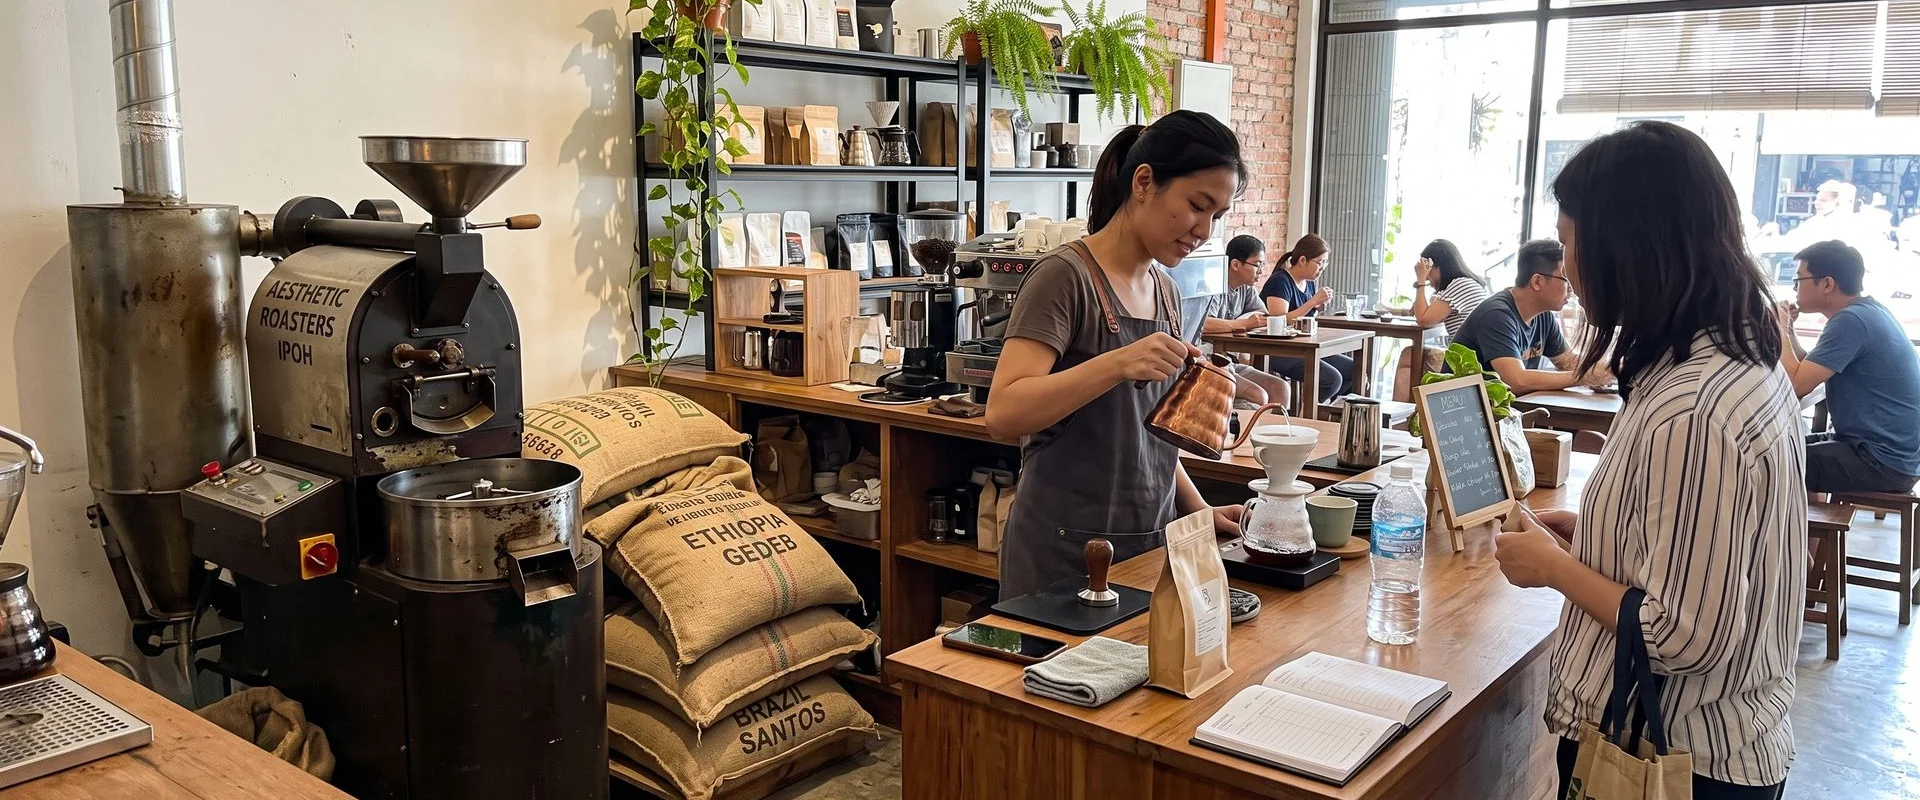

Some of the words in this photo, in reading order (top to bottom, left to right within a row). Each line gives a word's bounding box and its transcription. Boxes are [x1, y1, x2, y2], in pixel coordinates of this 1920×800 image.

[266, 280, 350, 308] AESTHETIC
[260, 306, 336, 338] ROASTERS
[278, 340, 313, 366] IPOH
[681, 513, 788, 550] ETHIOPIA
[722, 533, 798, 566] GEDEB
[732, 684, 811, 728] BRAZIL
[739, 701, 826, 754] SANTOS
